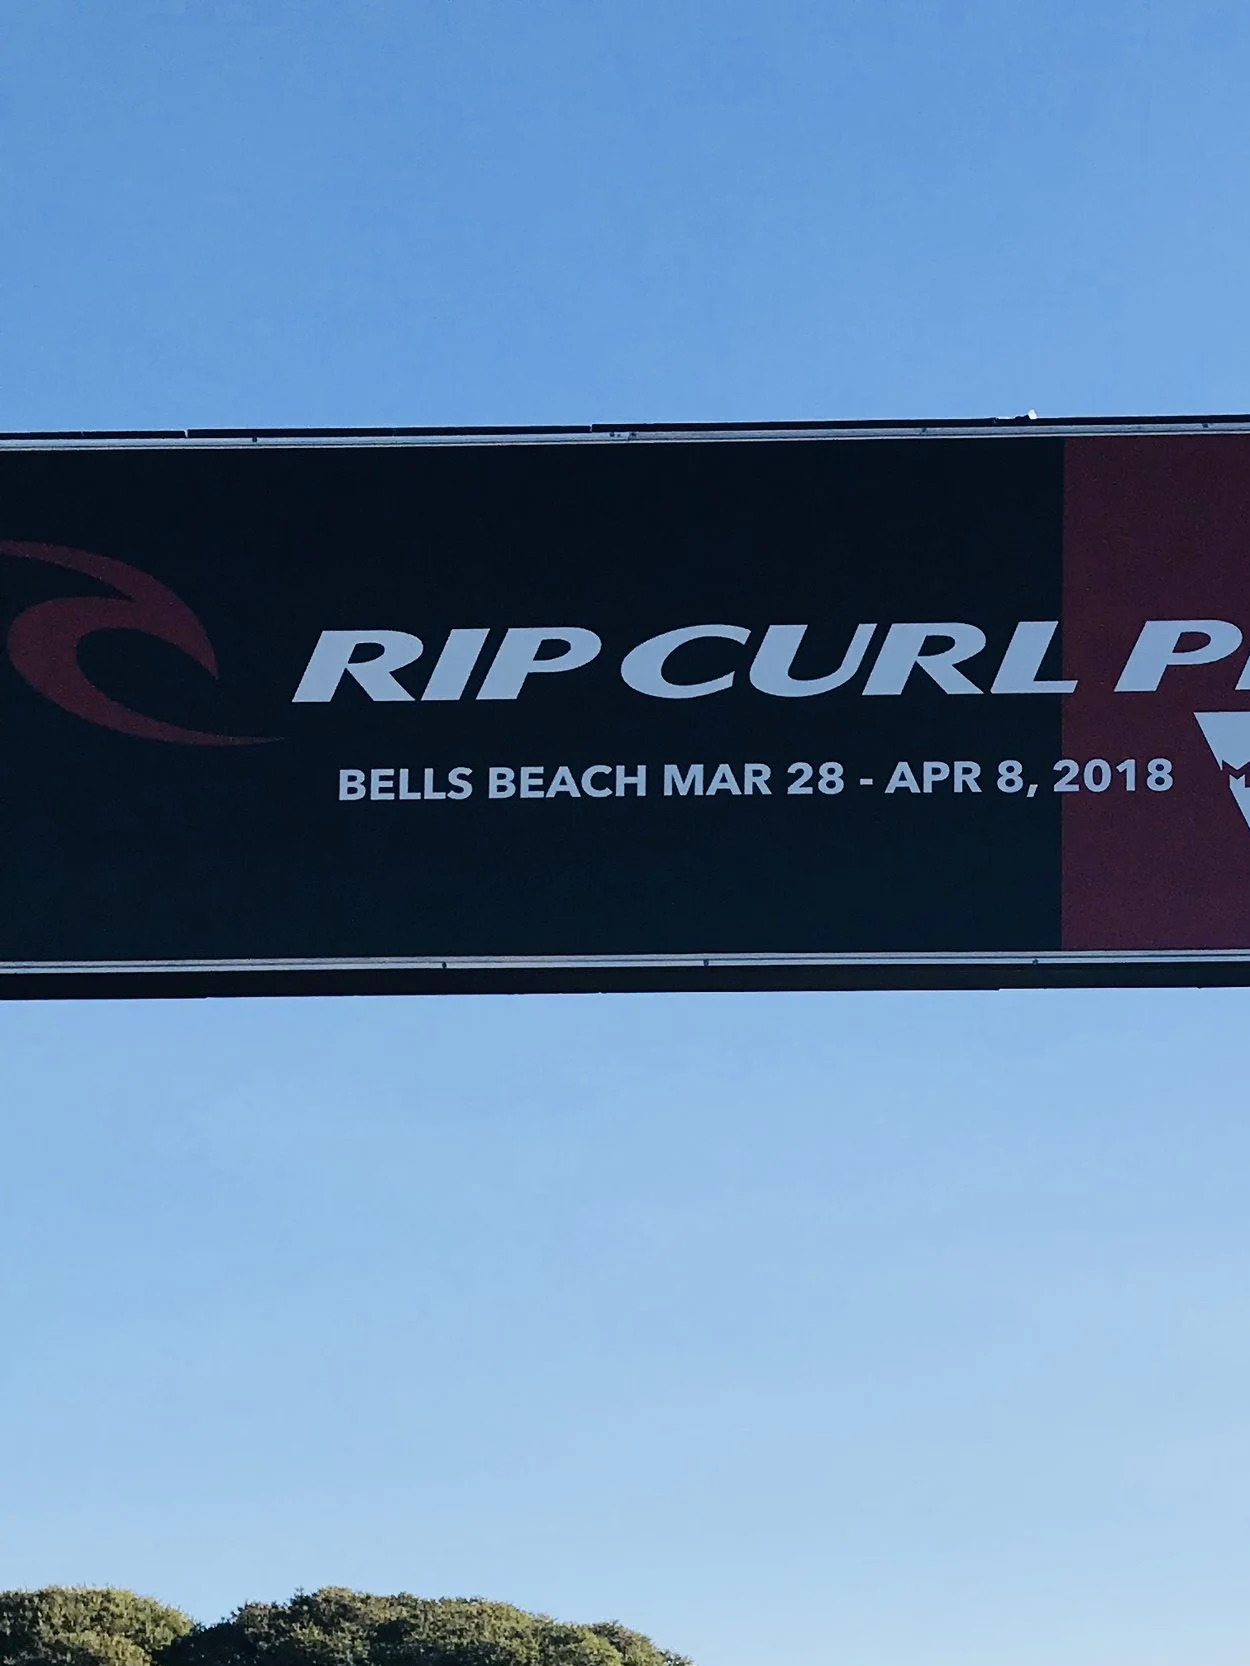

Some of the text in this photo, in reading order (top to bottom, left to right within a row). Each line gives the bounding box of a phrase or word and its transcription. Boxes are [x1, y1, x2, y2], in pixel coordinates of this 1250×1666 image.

[292, 627, 602, 702] RIP
[621, 621, 1079, 701] CURL
[338, 768, 473, 801] BELLS
[488, 764, 647, 799] BEACH
[663, 763, 772, 796] MAR
[787, 761, 845, 795] 28
[884, 760, 983, 794] APR
[996, 759, 1039, 798] 8,
[1053, 757, 1175, 792] 2018
